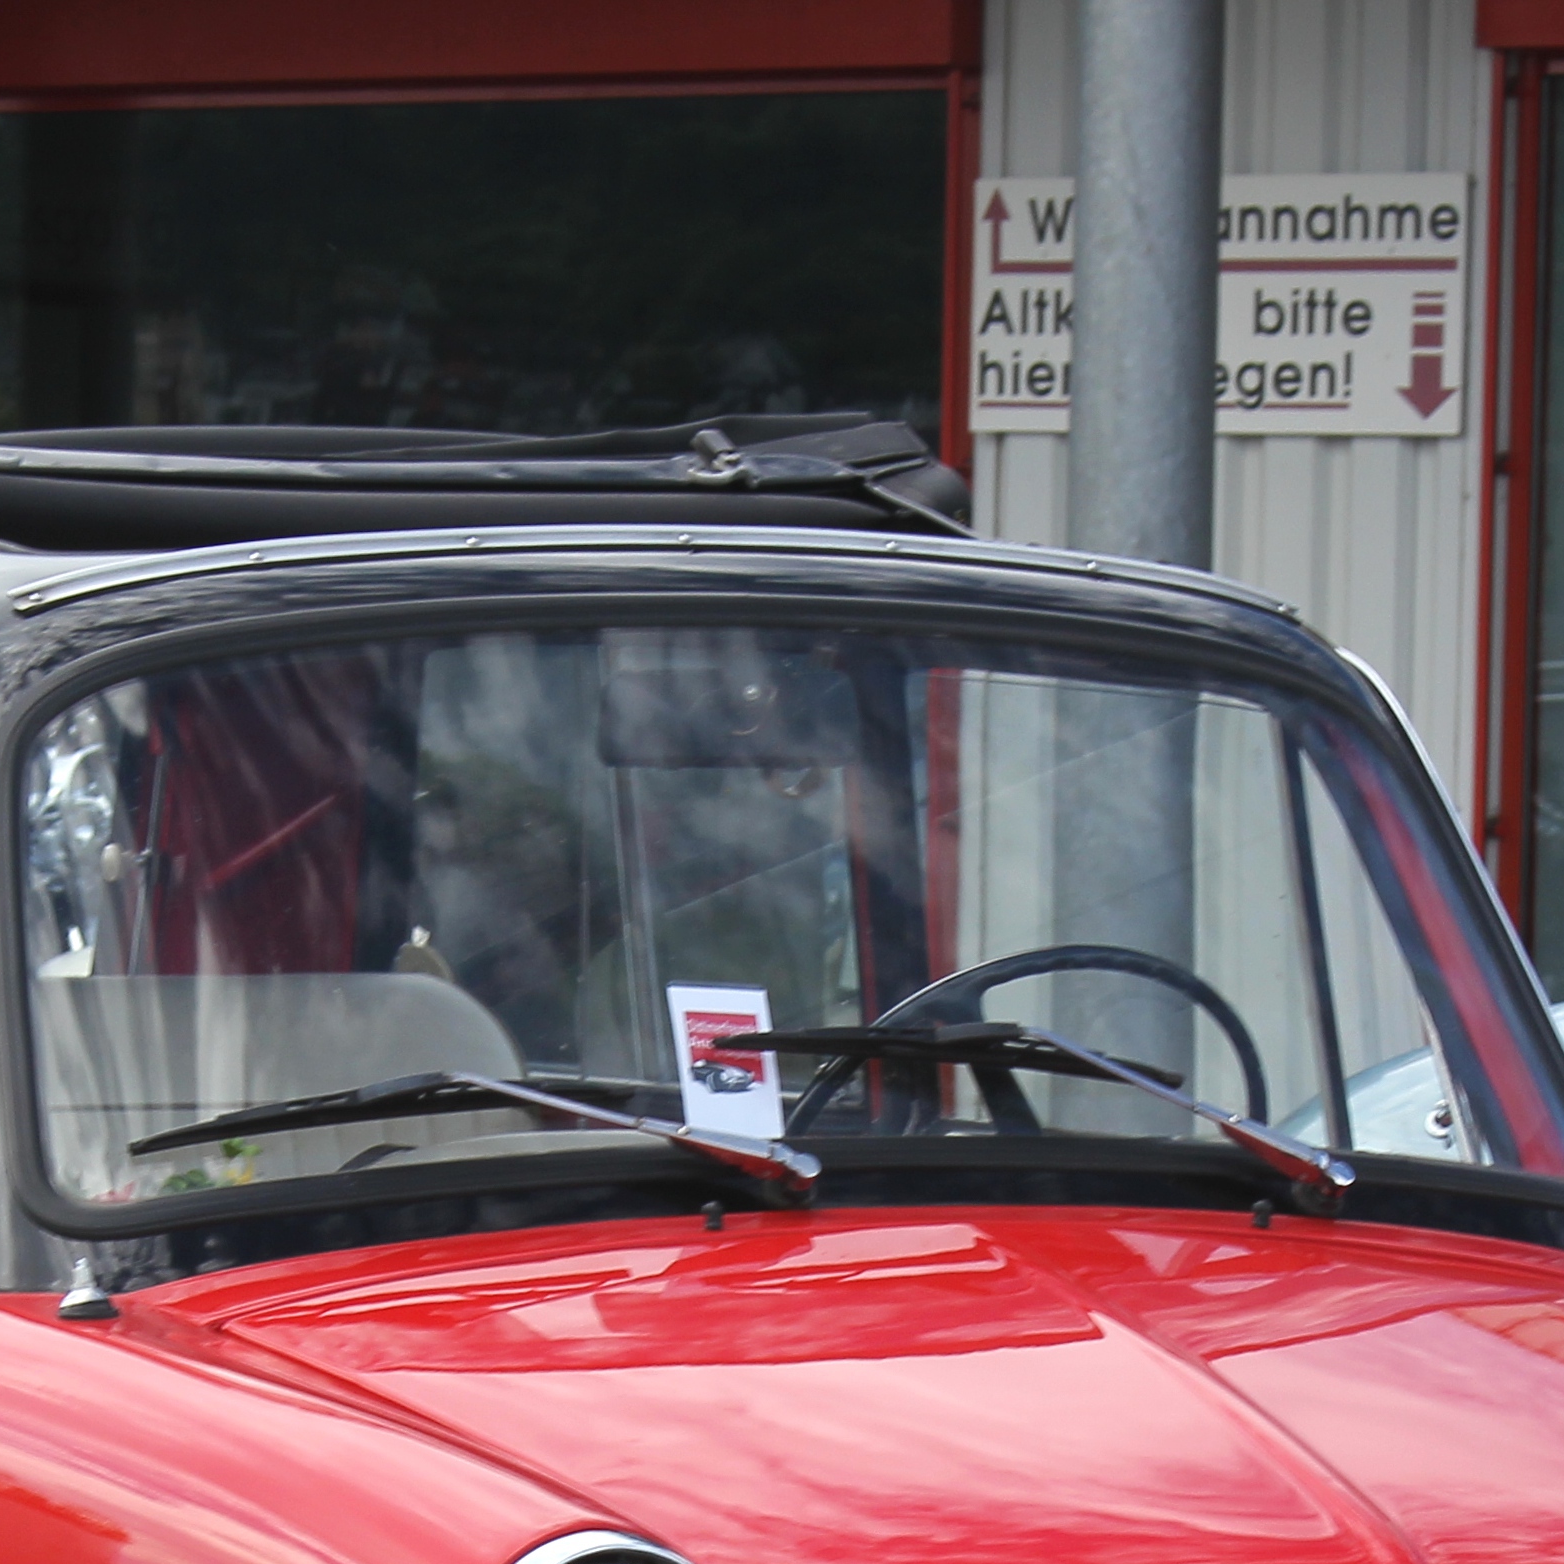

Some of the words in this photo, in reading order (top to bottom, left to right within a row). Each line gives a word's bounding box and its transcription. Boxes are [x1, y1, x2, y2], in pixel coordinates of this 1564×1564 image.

[1217, 192, 1459, 241] annahme
[978, 286, 1075, 336] Altk
[1253, 287, 1372, 336] bitte
[1214, 350, 1352, 410] egen!
